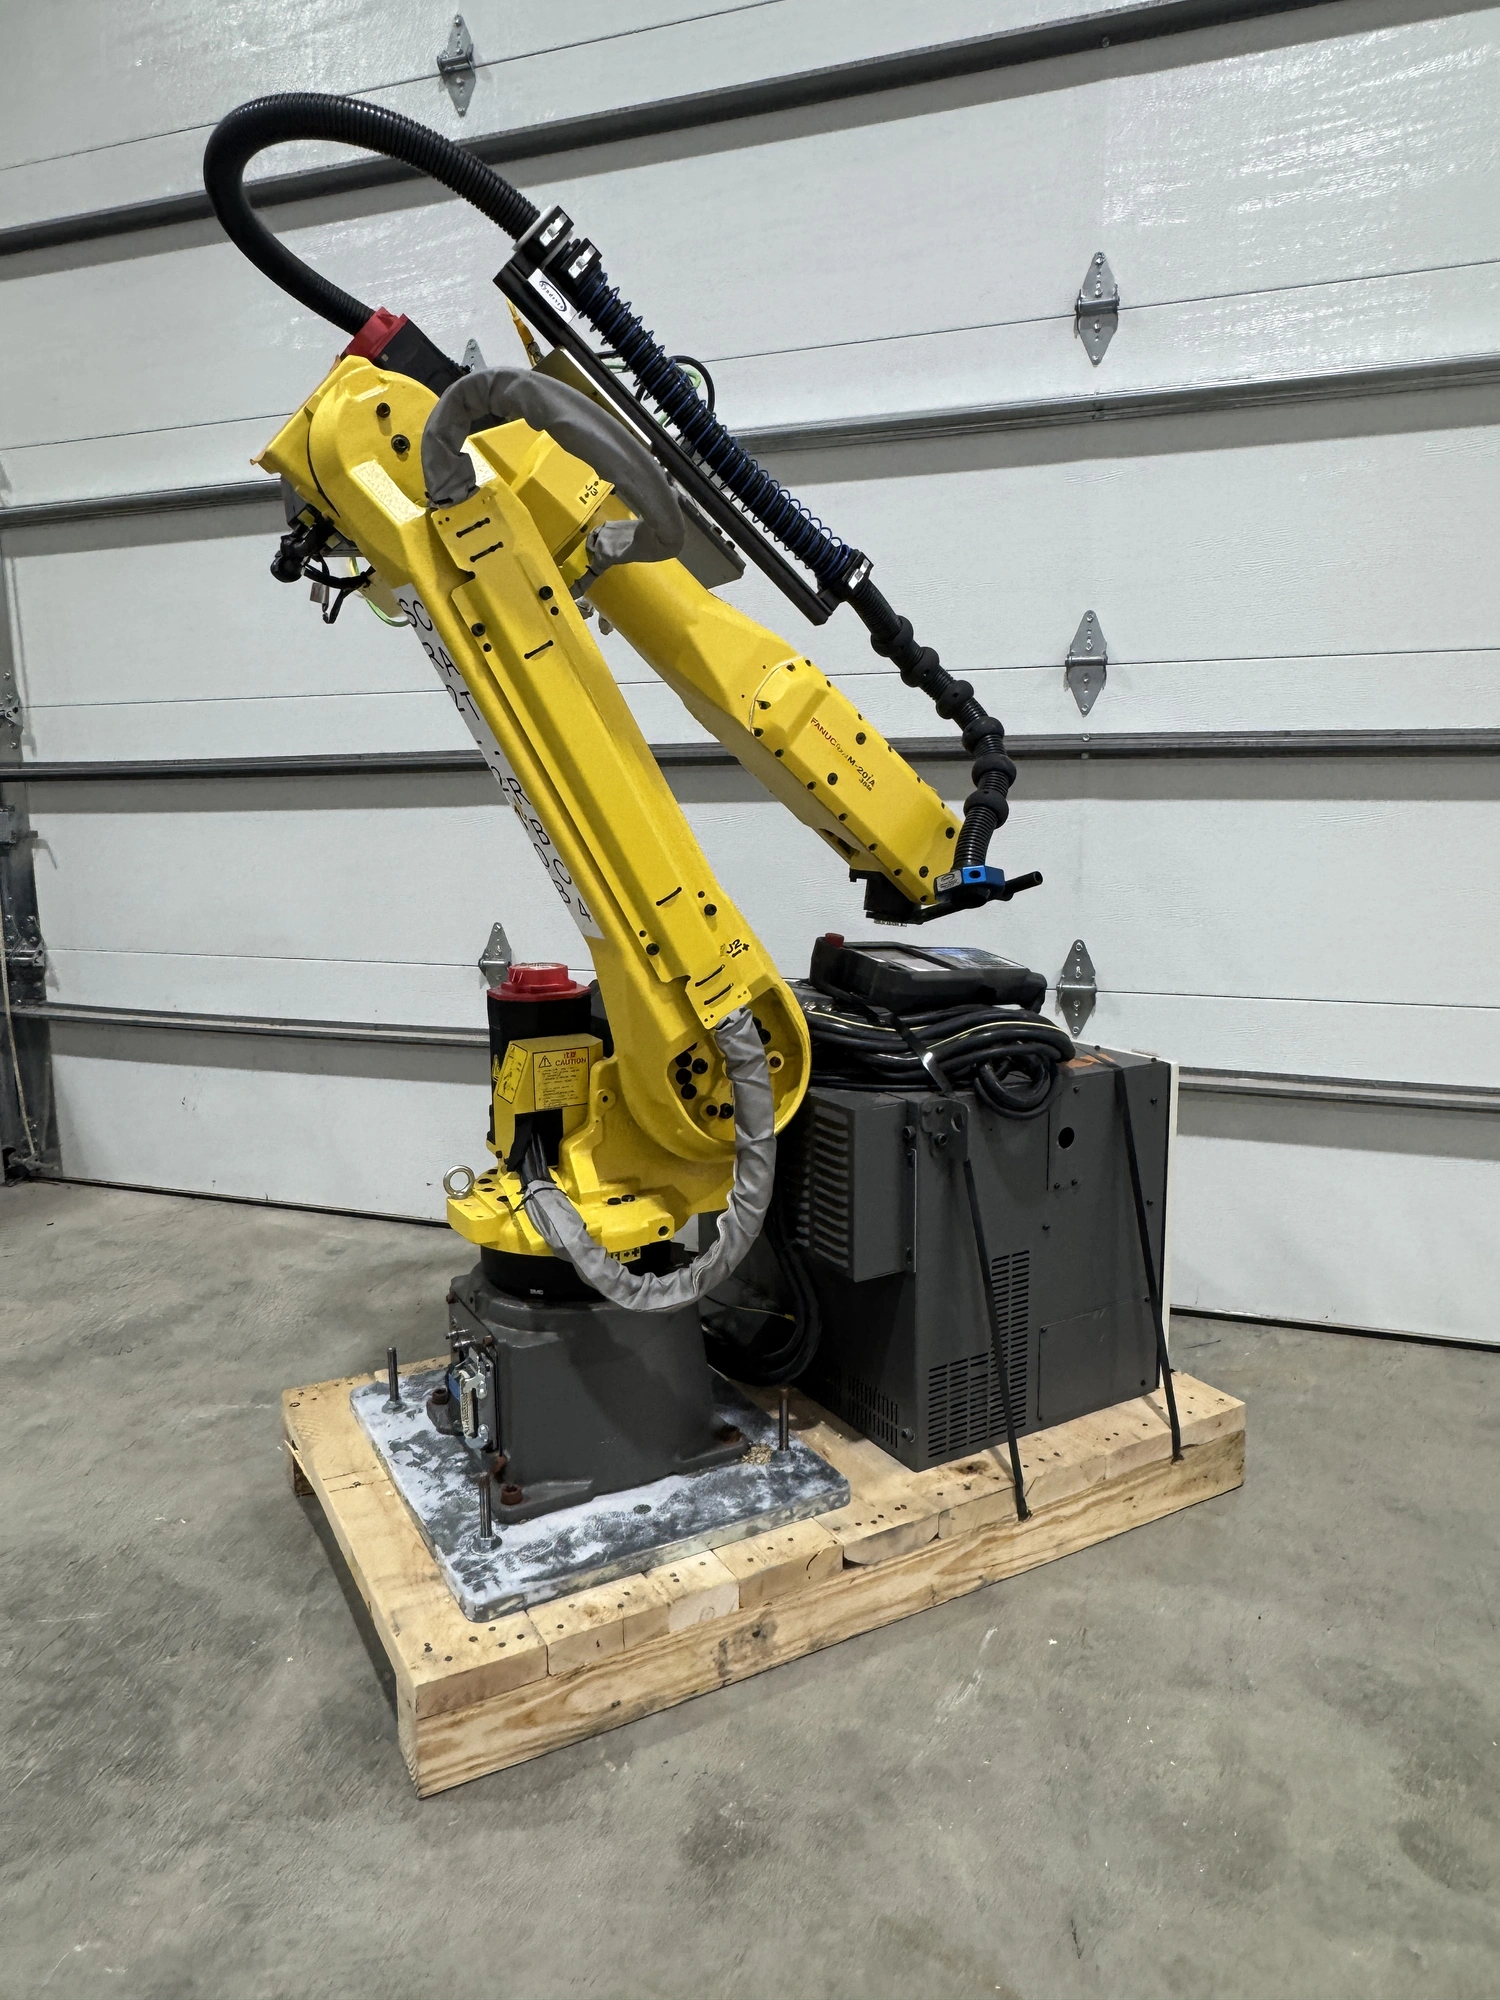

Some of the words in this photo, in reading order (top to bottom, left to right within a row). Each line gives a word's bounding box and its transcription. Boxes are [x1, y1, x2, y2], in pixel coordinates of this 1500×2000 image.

[810, 717, 837, 746] FANUC
[726, 938, 742, 954] J2
[555, 1057, 587, 1067] CAUTION
